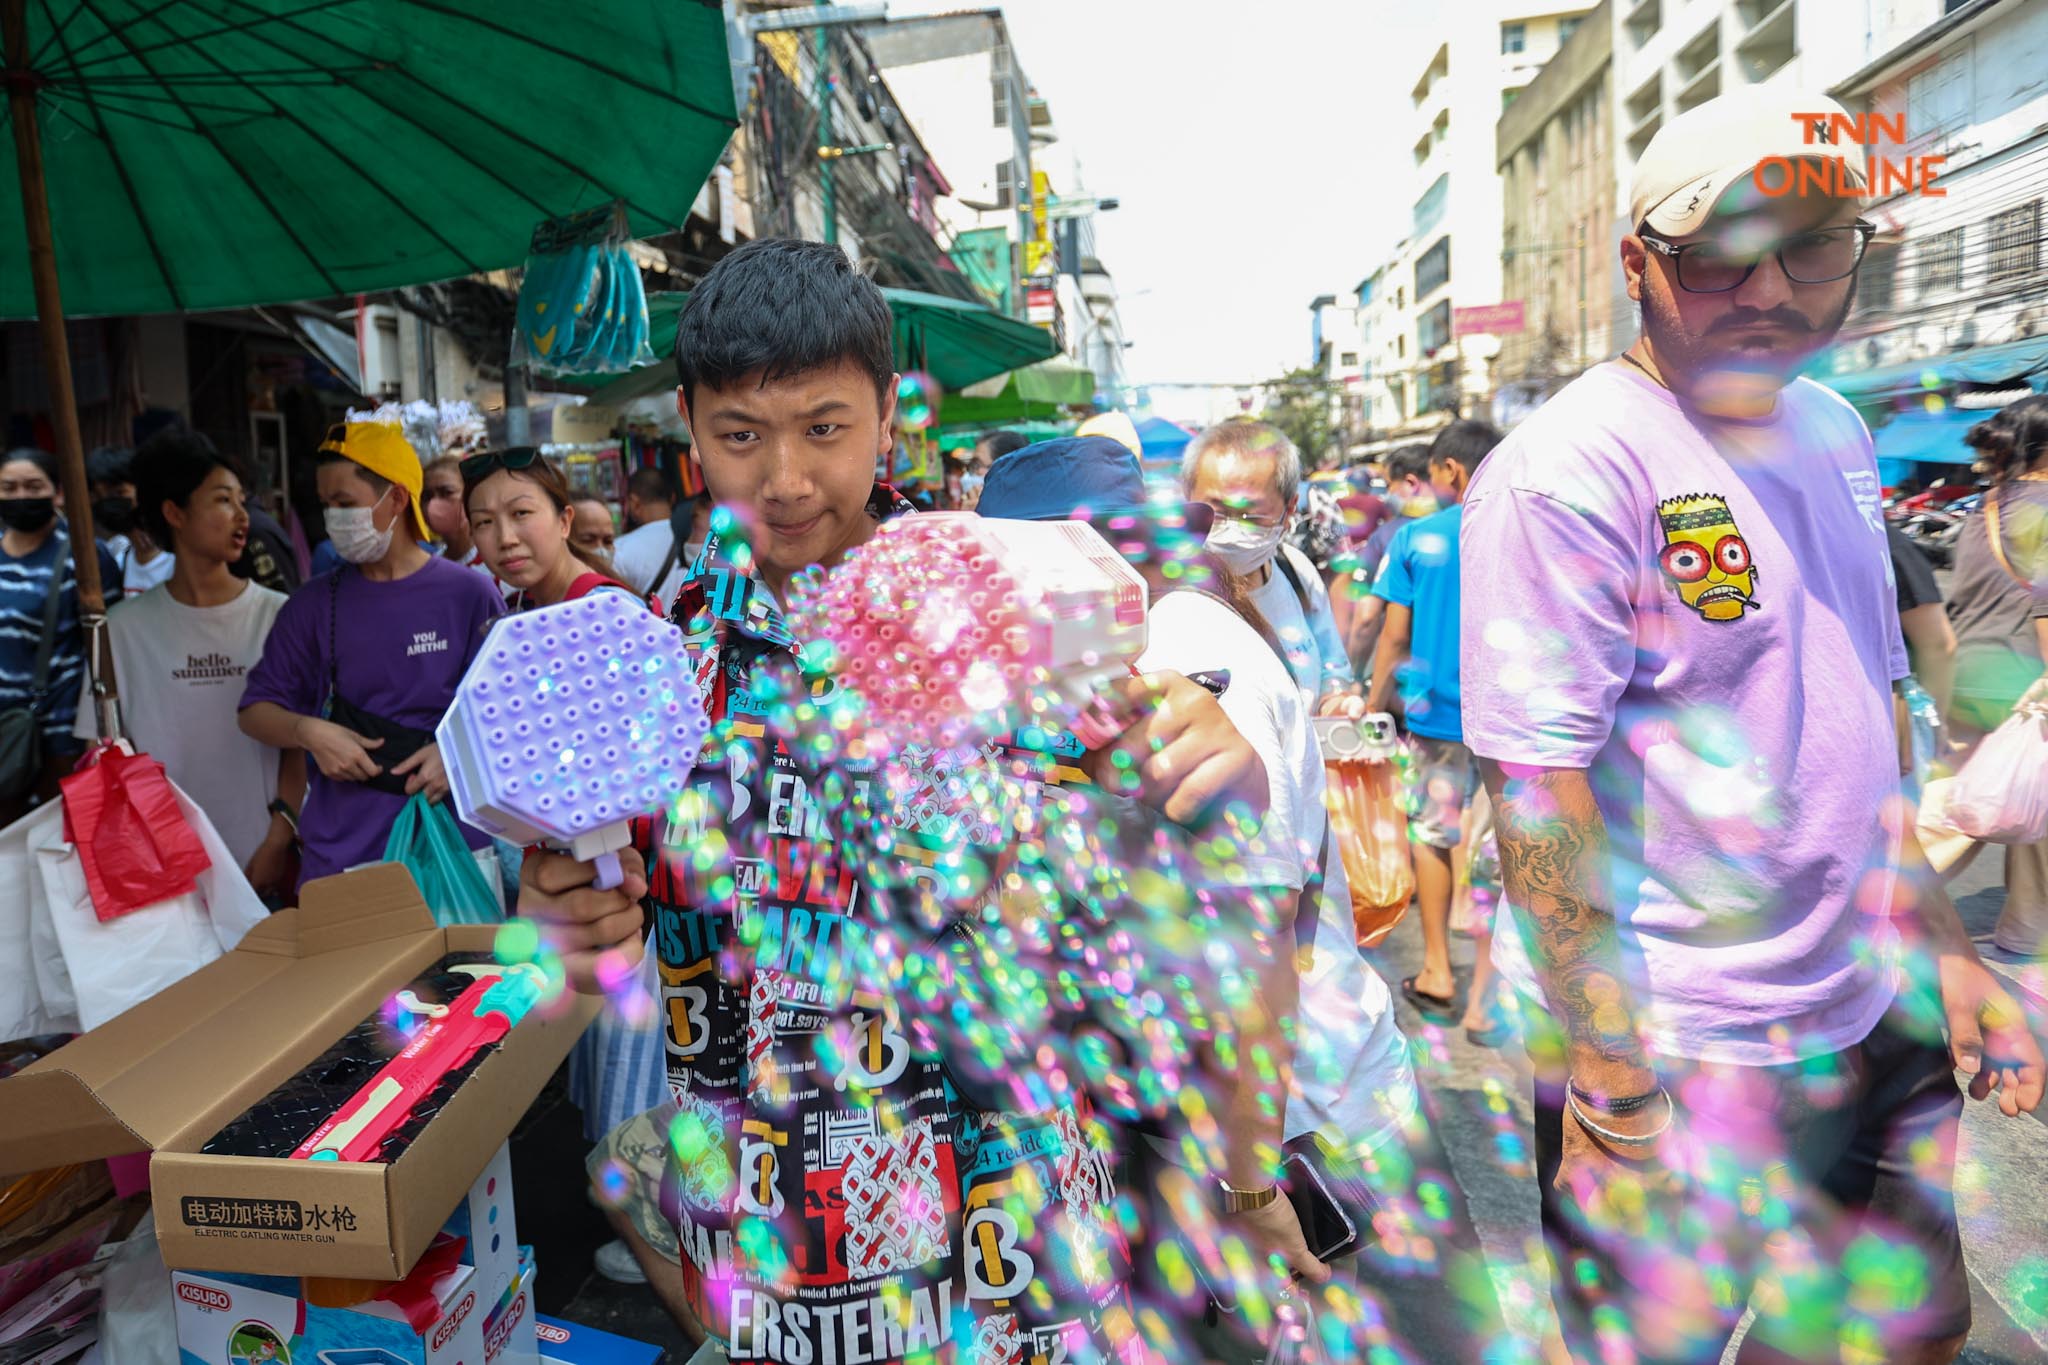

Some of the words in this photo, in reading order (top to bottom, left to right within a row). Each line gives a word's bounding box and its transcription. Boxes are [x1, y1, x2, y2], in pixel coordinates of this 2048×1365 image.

[413, 631, 436, 644] YOU
[187, 653, 231, 668] hello
[171, 665, 247, 680] summer
[793, 981, 823, 1004] BFO
[402, 1029, 429, 1059] Water
[300, 1123, 333, 1152] Electric
[194, 1228, 238, 1239] ELECTRIC
[240, 1231, 279, 1241] GATLING
[281, 1233, 313, 1243] WATER
[315, 1234, 336, 1244] GUN
[180, 1284, 229, 1307] KISUBO
[435, 1295, 473, 1347] KISUBO
